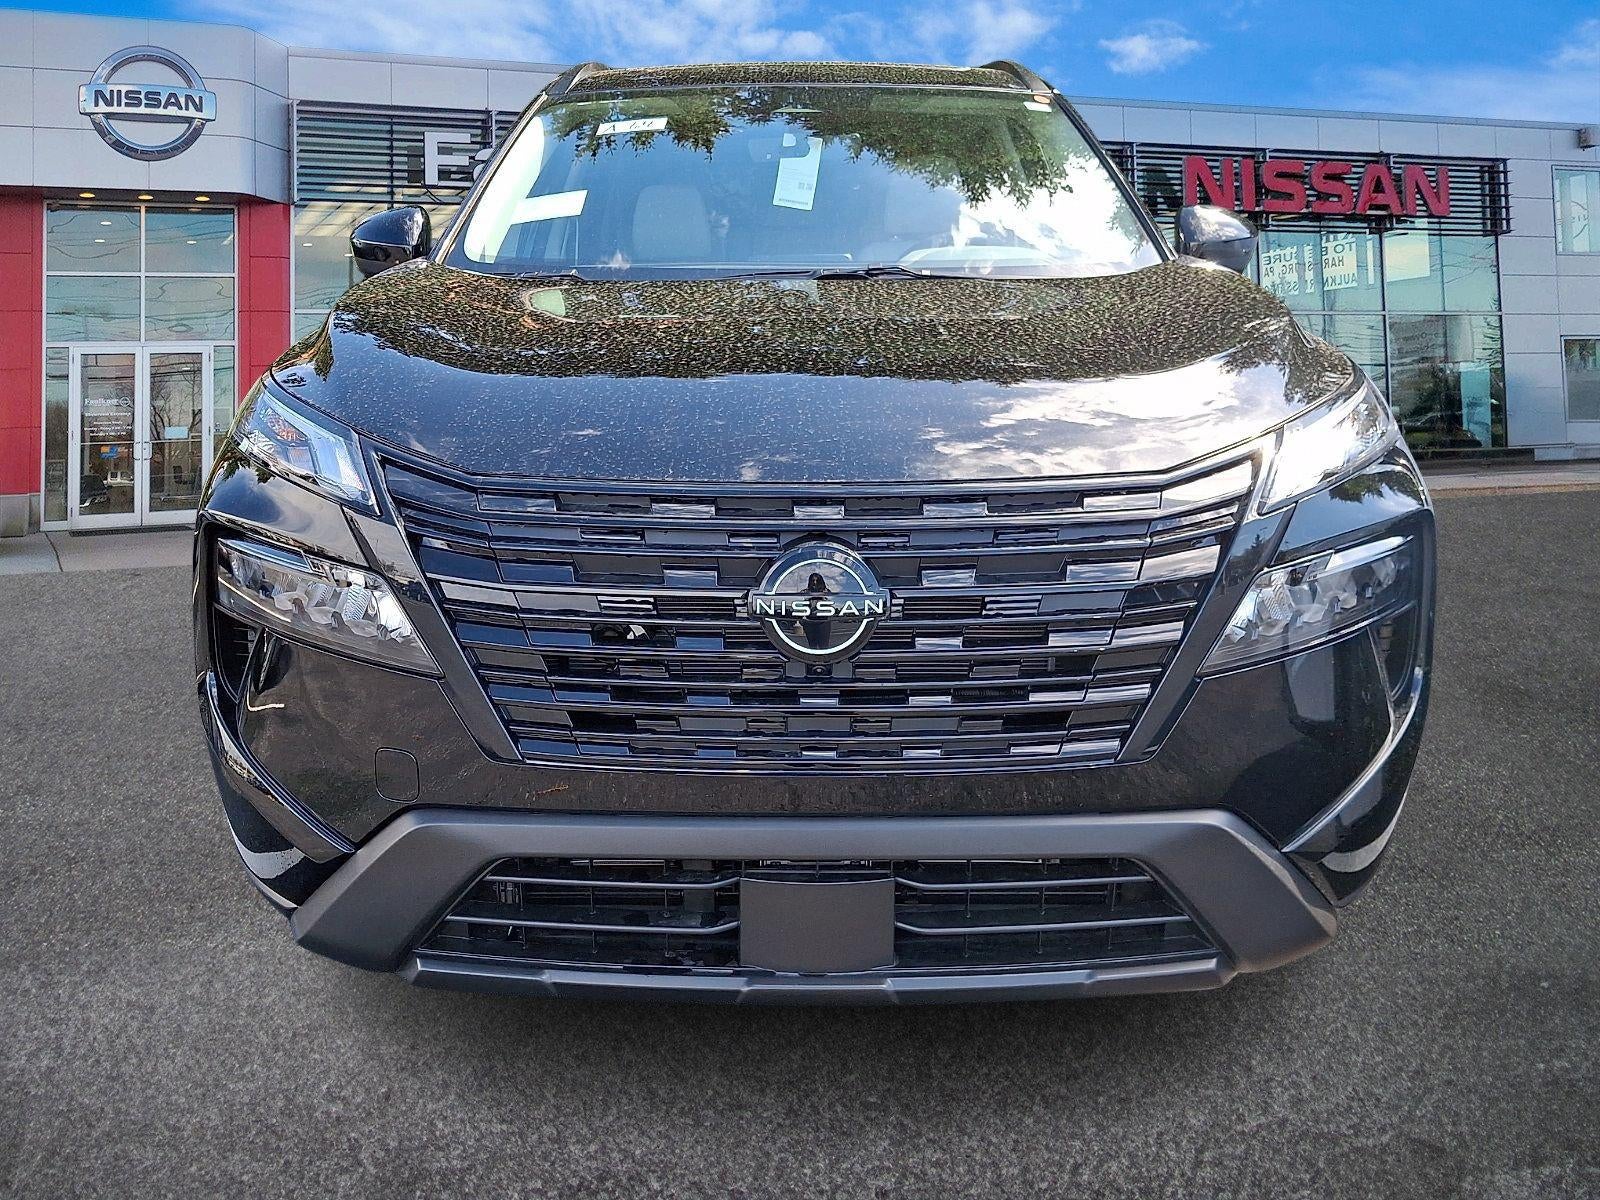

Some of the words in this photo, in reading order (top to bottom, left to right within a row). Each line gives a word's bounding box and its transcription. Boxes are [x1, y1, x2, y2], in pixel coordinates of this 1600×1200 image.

[94, 90, 203, 113] NISSAN
[1182, 155, 1450, 216] NISSAN
[756, 599, 884, 617] NISSAN
